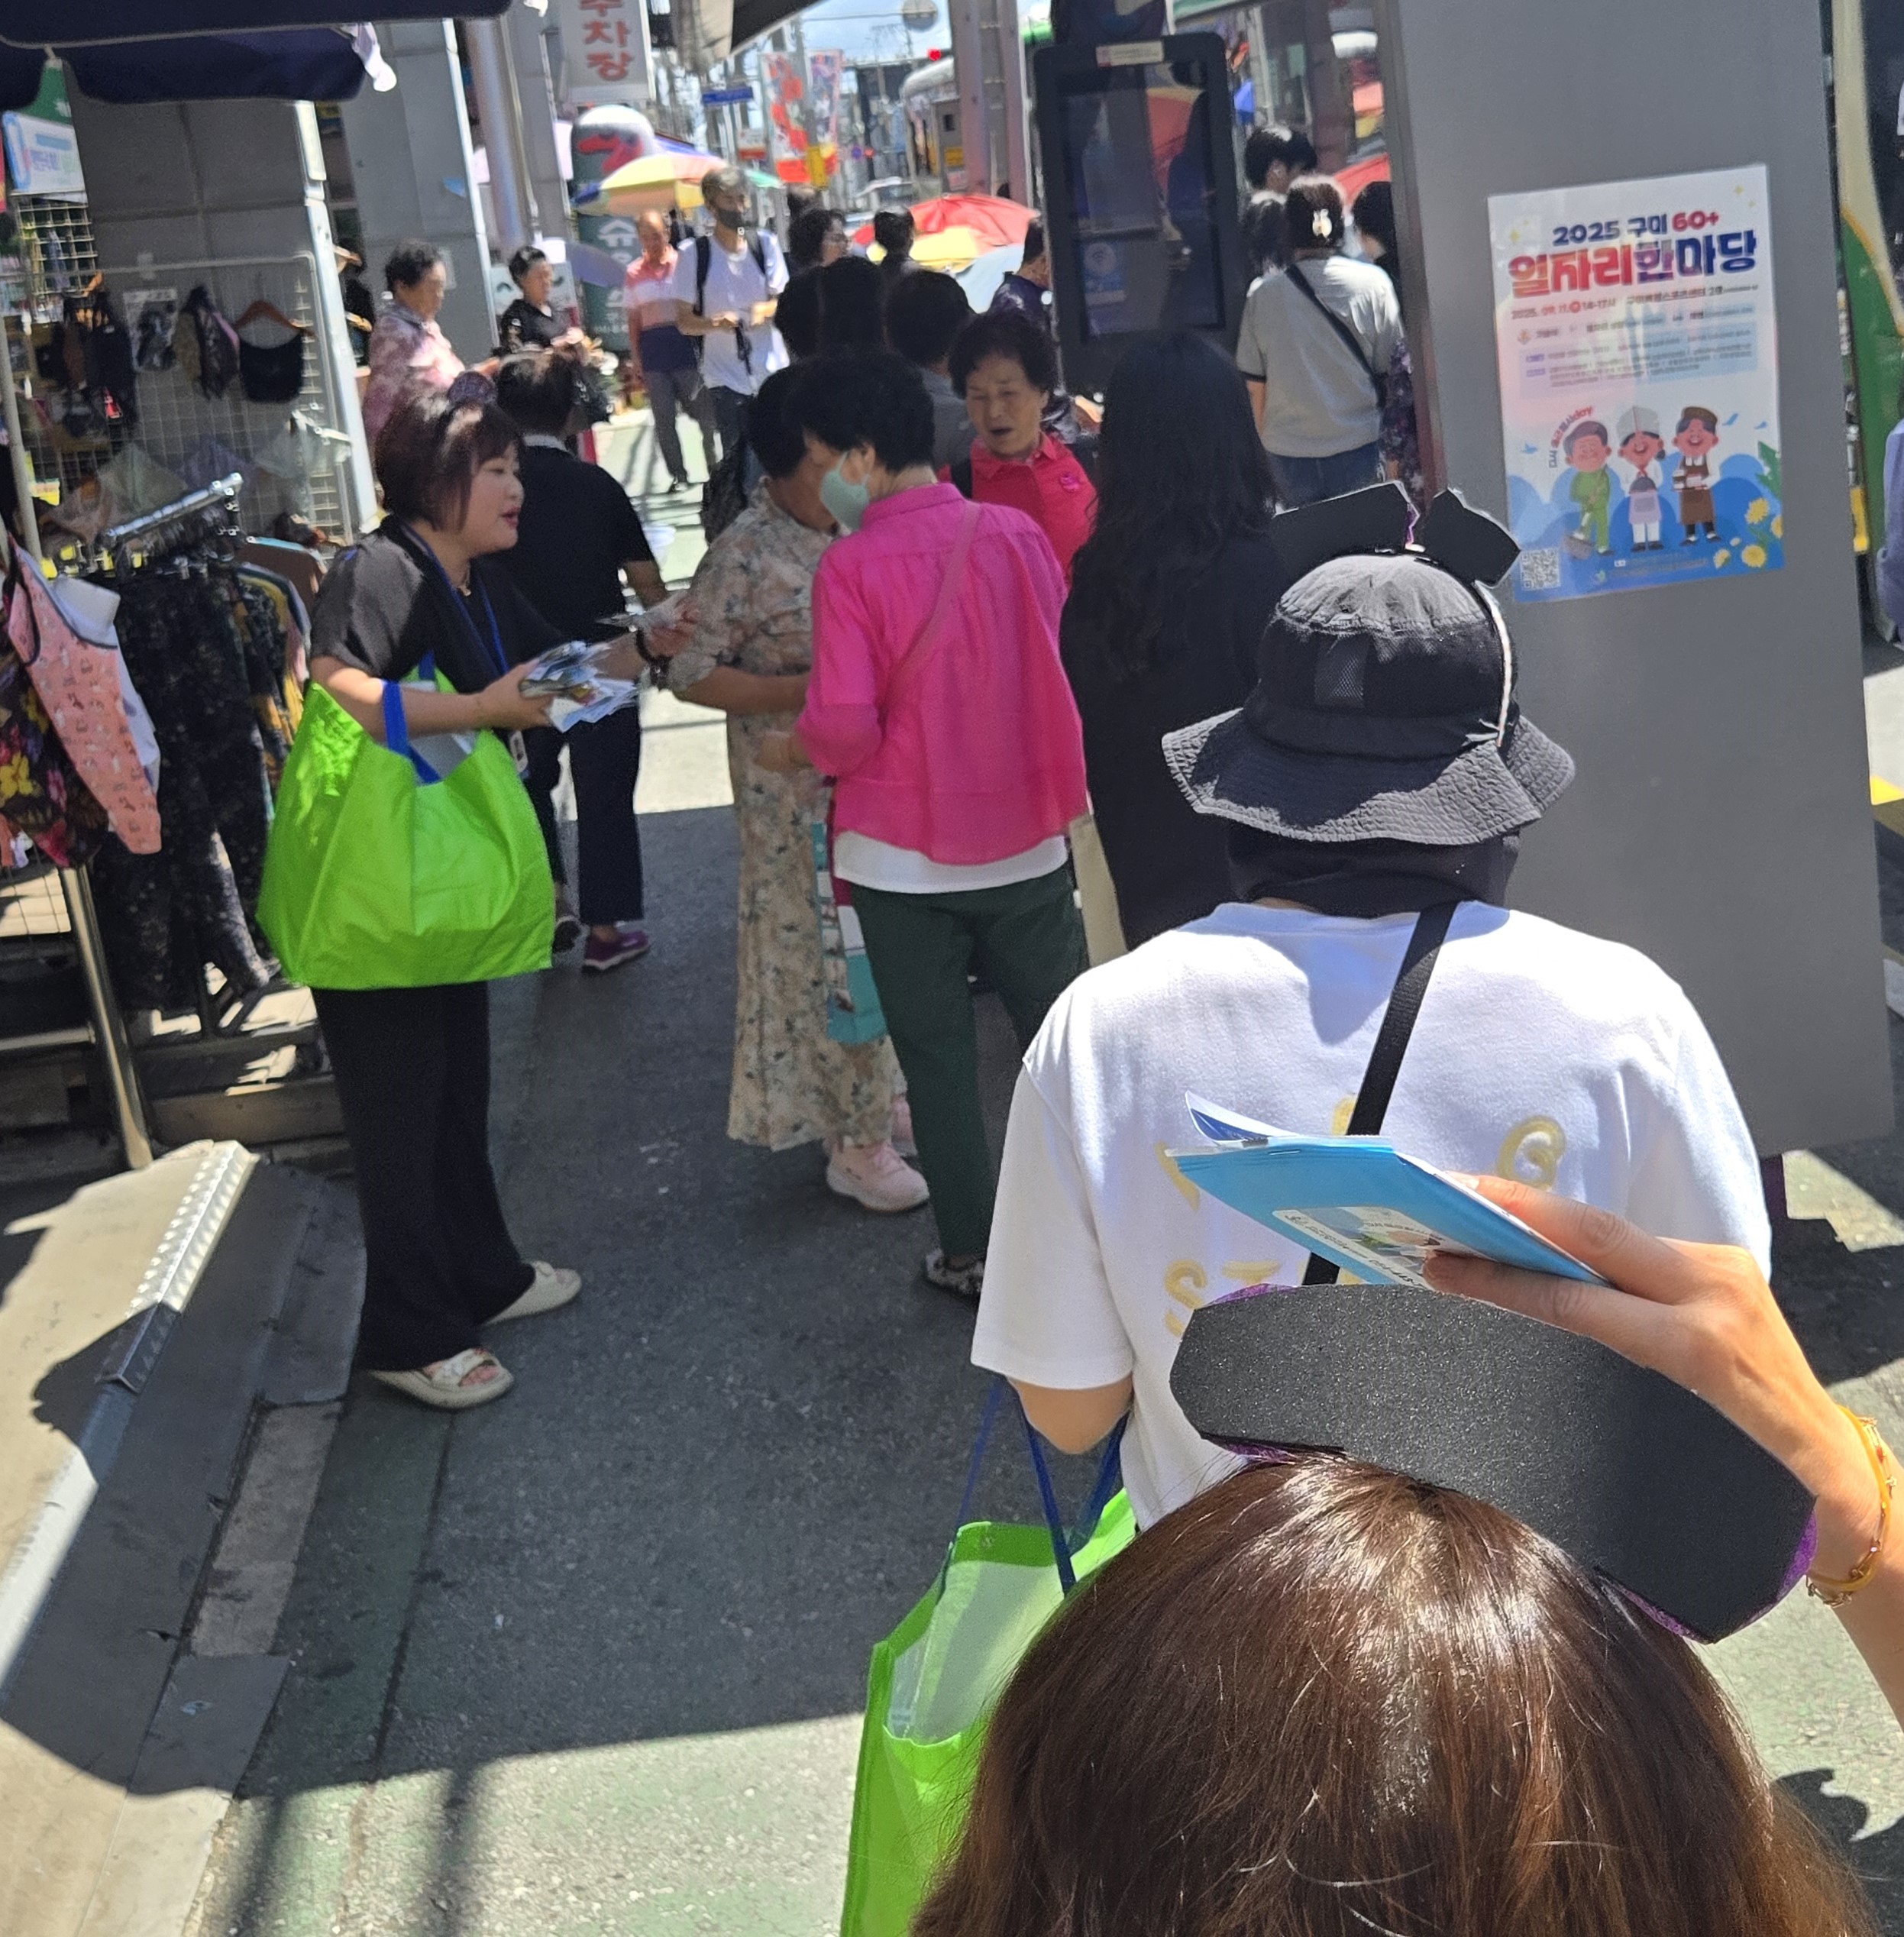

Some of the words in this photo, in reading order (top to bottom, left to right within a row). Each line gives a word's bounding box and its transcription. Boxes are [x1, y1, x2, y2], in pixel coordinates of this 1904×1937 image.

[1552, 220, 1620, 246] 2025
[1626, 212, 1668, 238] 구미
[1670, 209, 1720, 233] 60+
[1508, 229, 1757, 299] 일자리한마당
